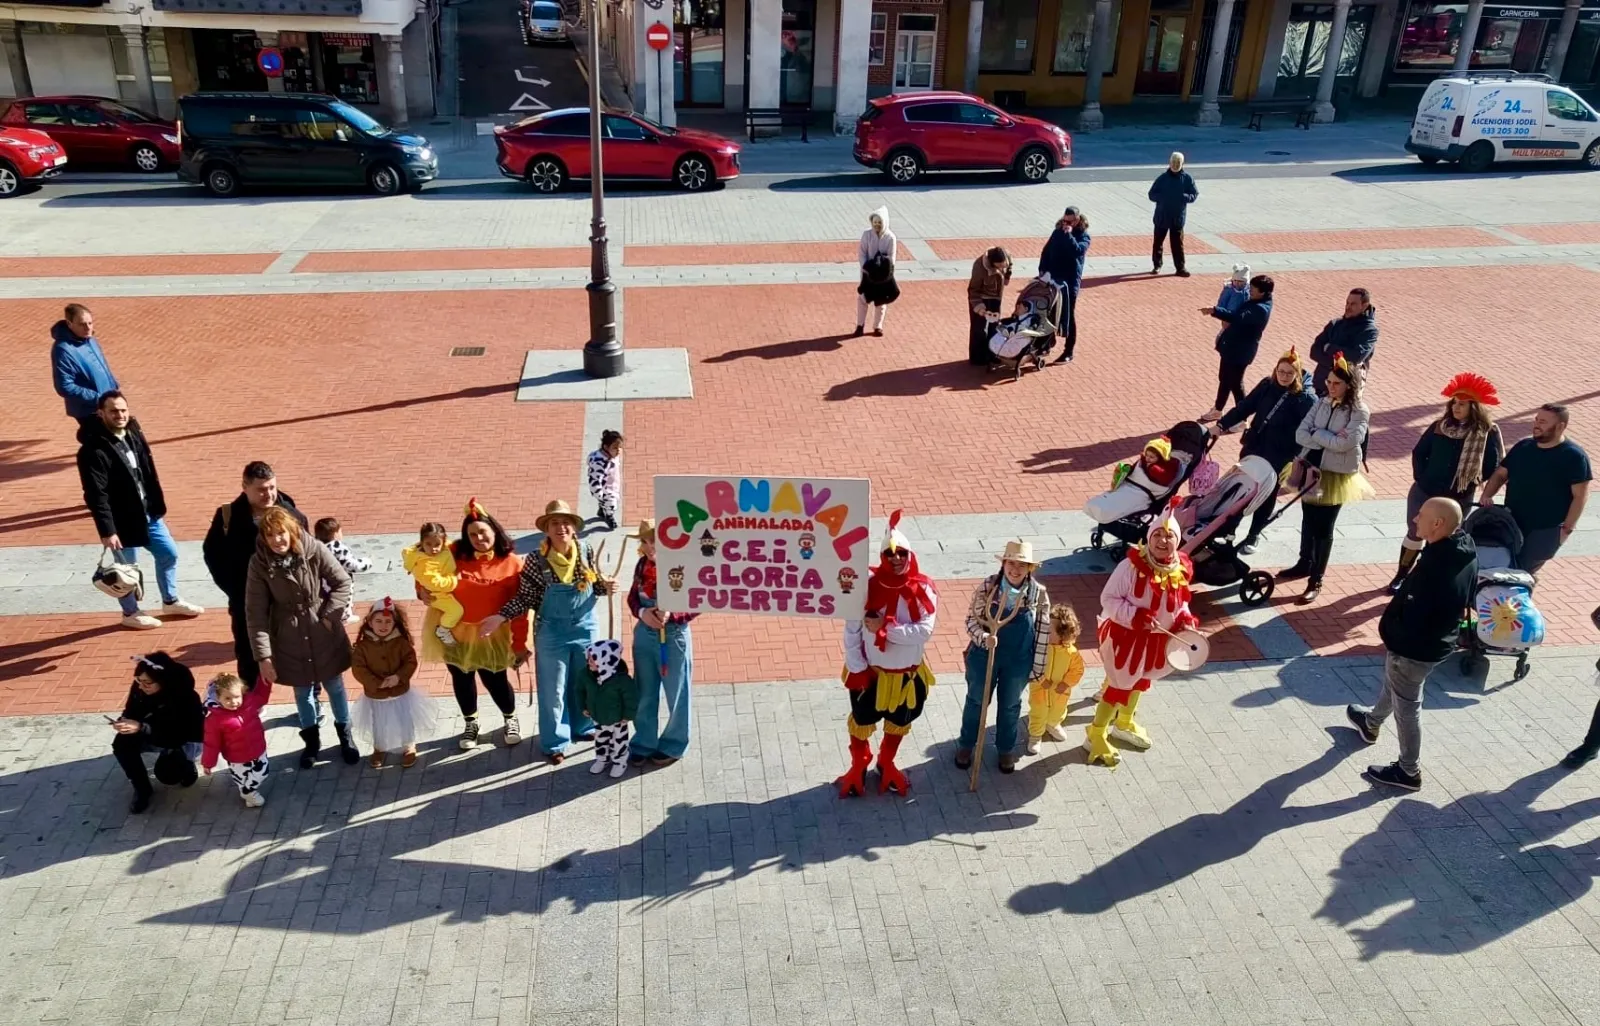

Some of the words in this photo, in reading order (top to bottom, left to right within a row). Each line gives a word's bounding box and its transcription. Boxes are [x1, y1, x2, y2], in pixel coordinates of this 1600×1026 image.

[1441, 96, 1454, 110] 24
[1503, 99, 1521, 113] 24
[1471, 118, 1514, 126] ASCENSORES
[1516, 118, 1538, 126] SODEL
[1481, 127, 1496, 135] 633
[1497, 127, 1512, 135] 205
[1514, 127, 1530, 135] 300
[1511, 148, 1566, 157] MULTIMARCA
[658, 478, 869, 562] CARNAVAL
[688, 587, 836, 615] FUERTES
